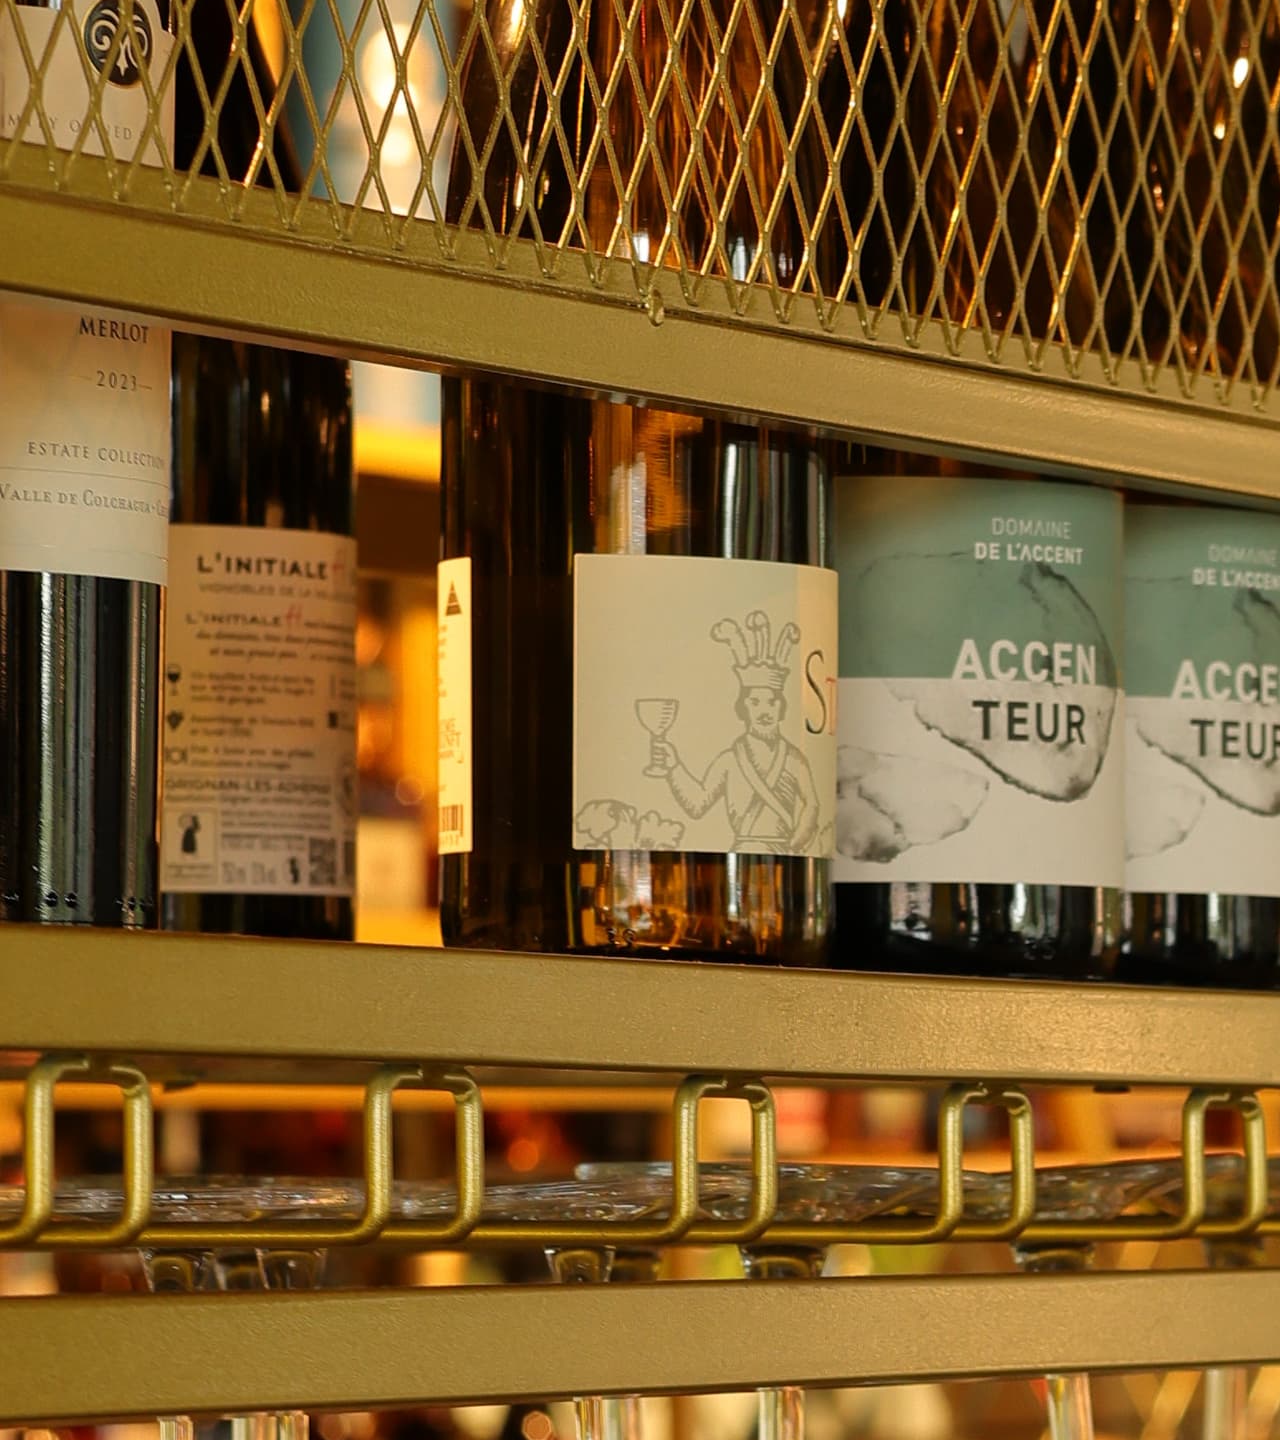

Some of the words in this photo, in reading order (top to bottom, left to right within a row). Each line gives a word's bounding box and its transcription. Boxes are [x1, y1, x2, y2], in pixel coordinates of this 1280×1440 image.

[78, 314, 150, 344] MERLOT
[96, 370, 139, 392] 2023
[27, 441, 90, 460] ESTATE
[58, 491, 78, 505] DE
[991, 516, 1072, 541] DOMAINE
[197, 551, 328, 580] L'INITIALE
[974, 540, 1001, 561] DE
[1006, 541, 1084, 566] L'ACCENT
[1208, 543, 1278, 568] DOMAINE
[1192, 567, 1216, 587] DE
[951, 638, 1098, 686] ACCEN
[972, 699, 1087, 745] TEUR
